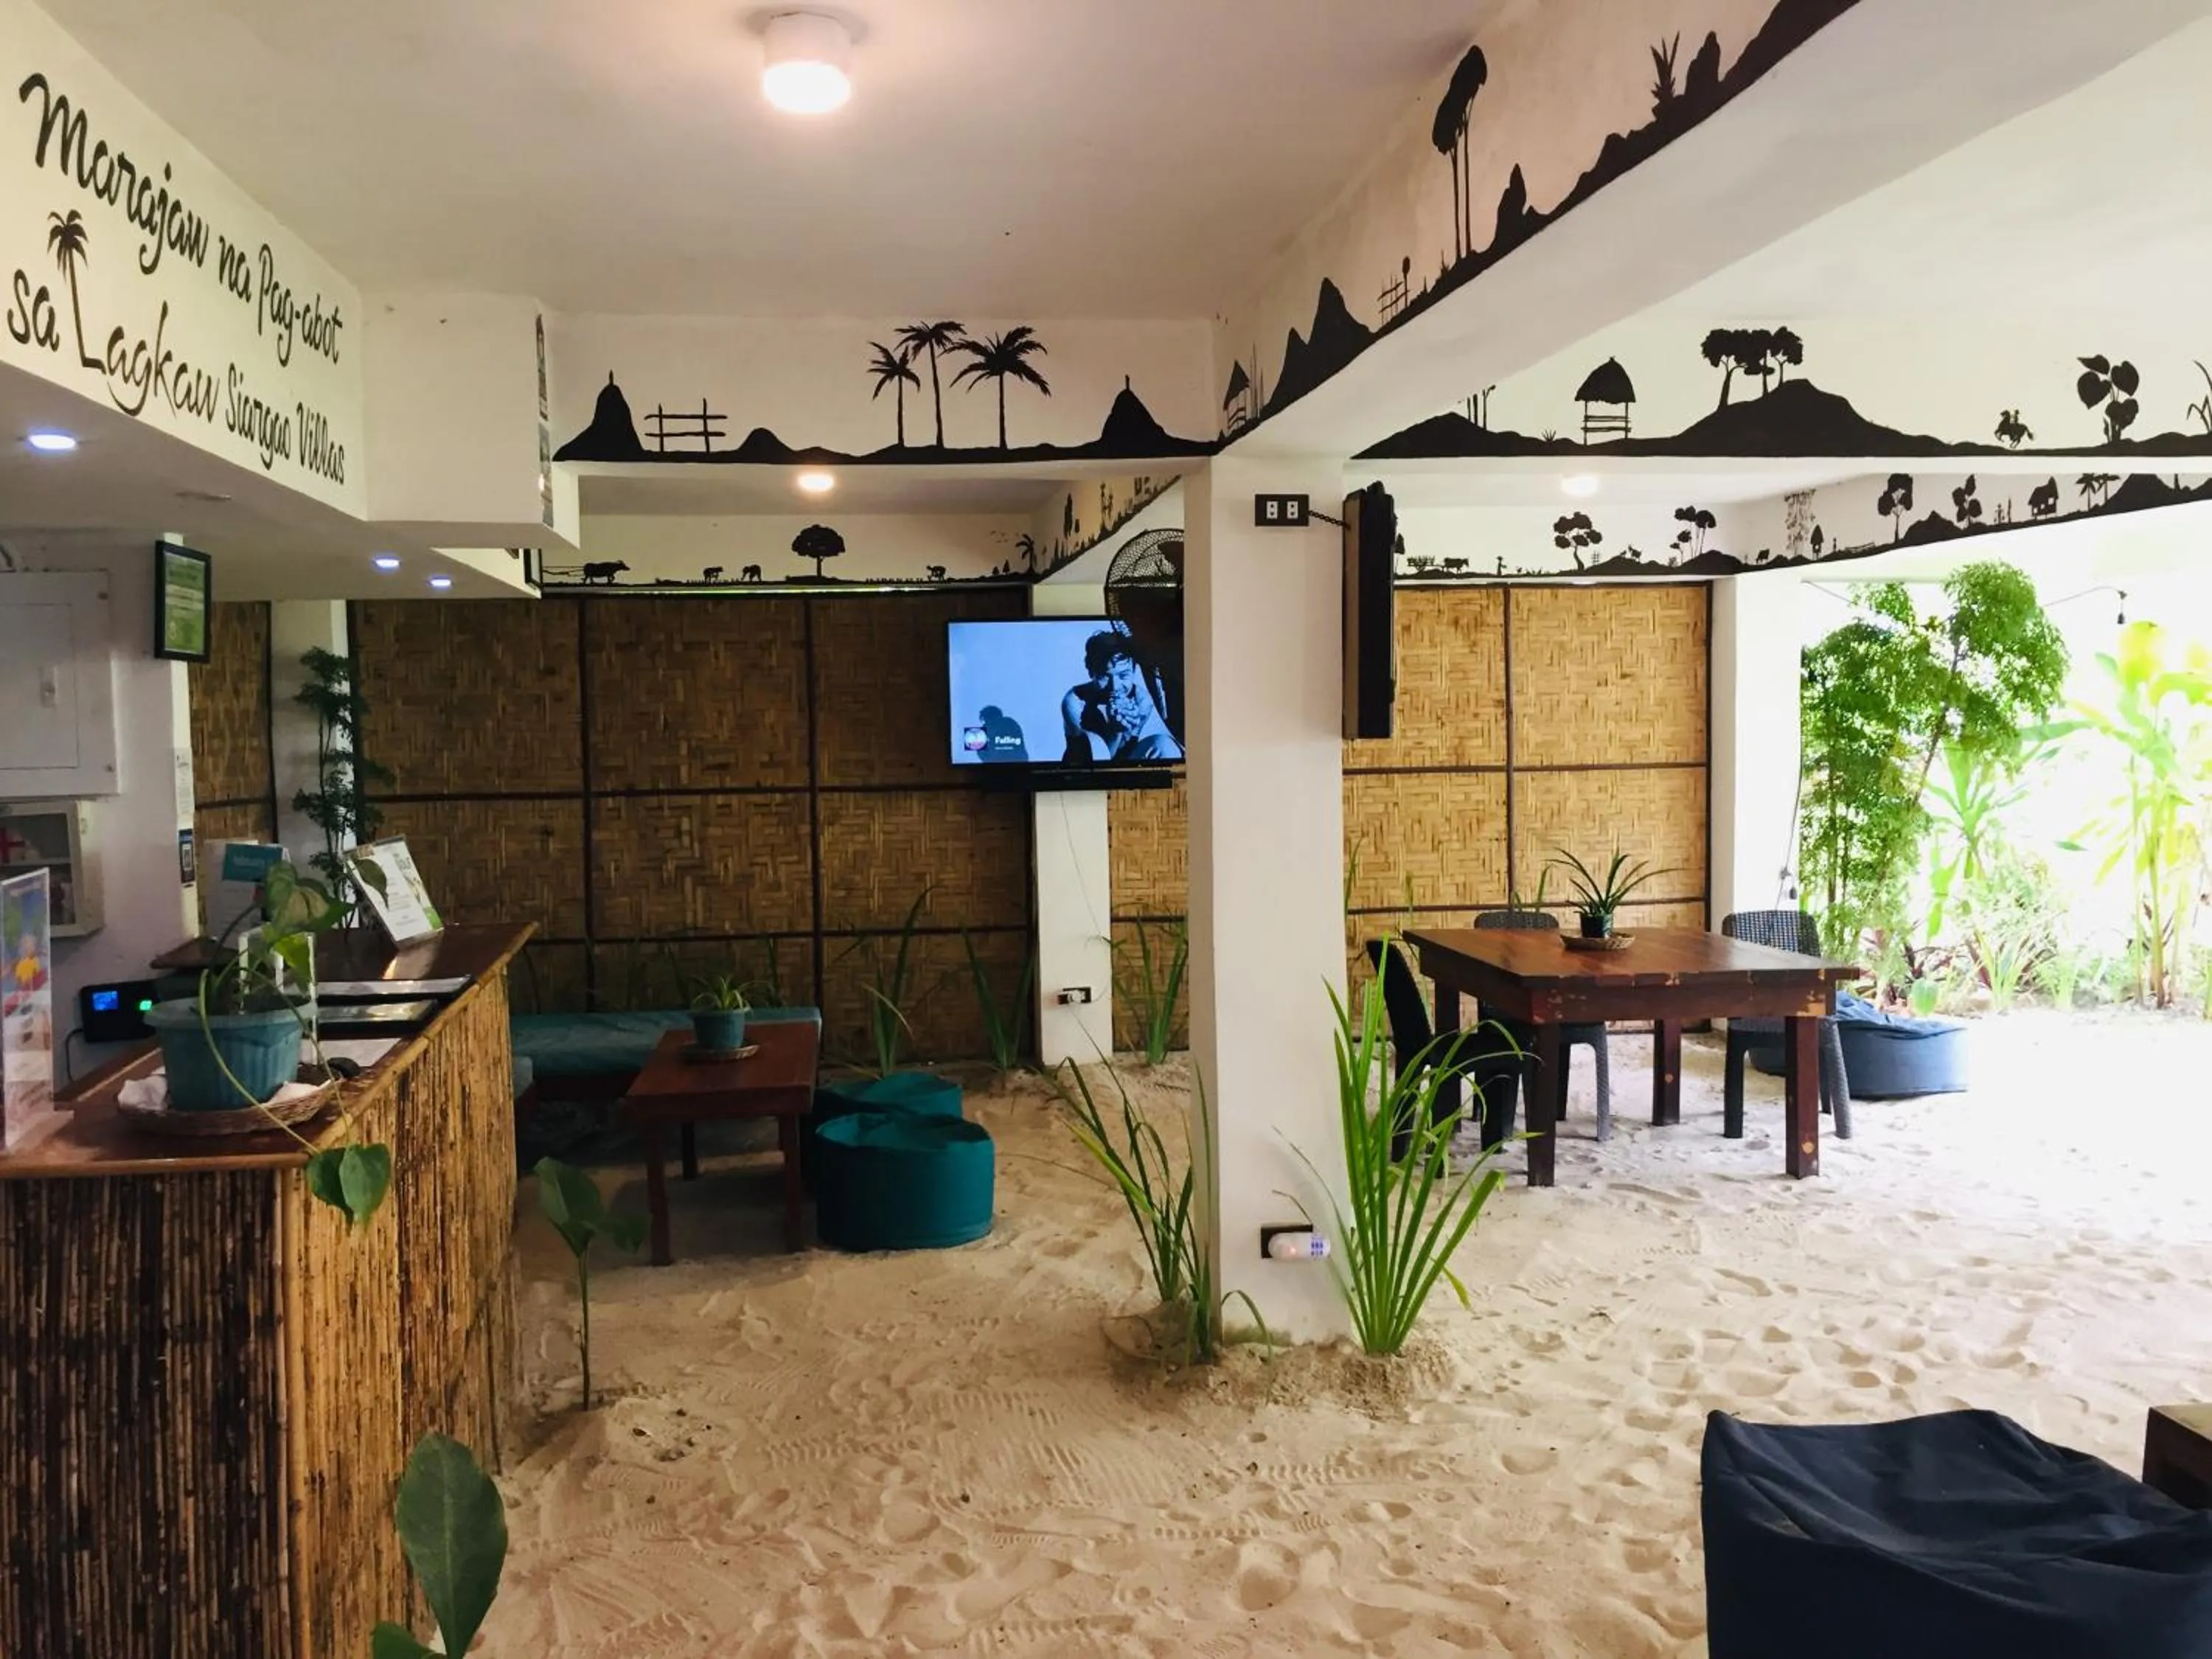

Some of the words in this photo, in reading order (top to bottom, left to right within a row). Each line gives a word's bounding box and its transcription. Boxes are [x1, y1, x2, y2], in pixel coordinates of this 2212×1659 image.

[19, 72, 209, 275] Marajaw
[219, 234, 251, 303] na
[258, 243, 343, 367] Pag-abot
[47, 209, 220, 423] Lagkaw
[225, 362, 291, 470] Siargao
[296, 401, 344, 485] Villas
